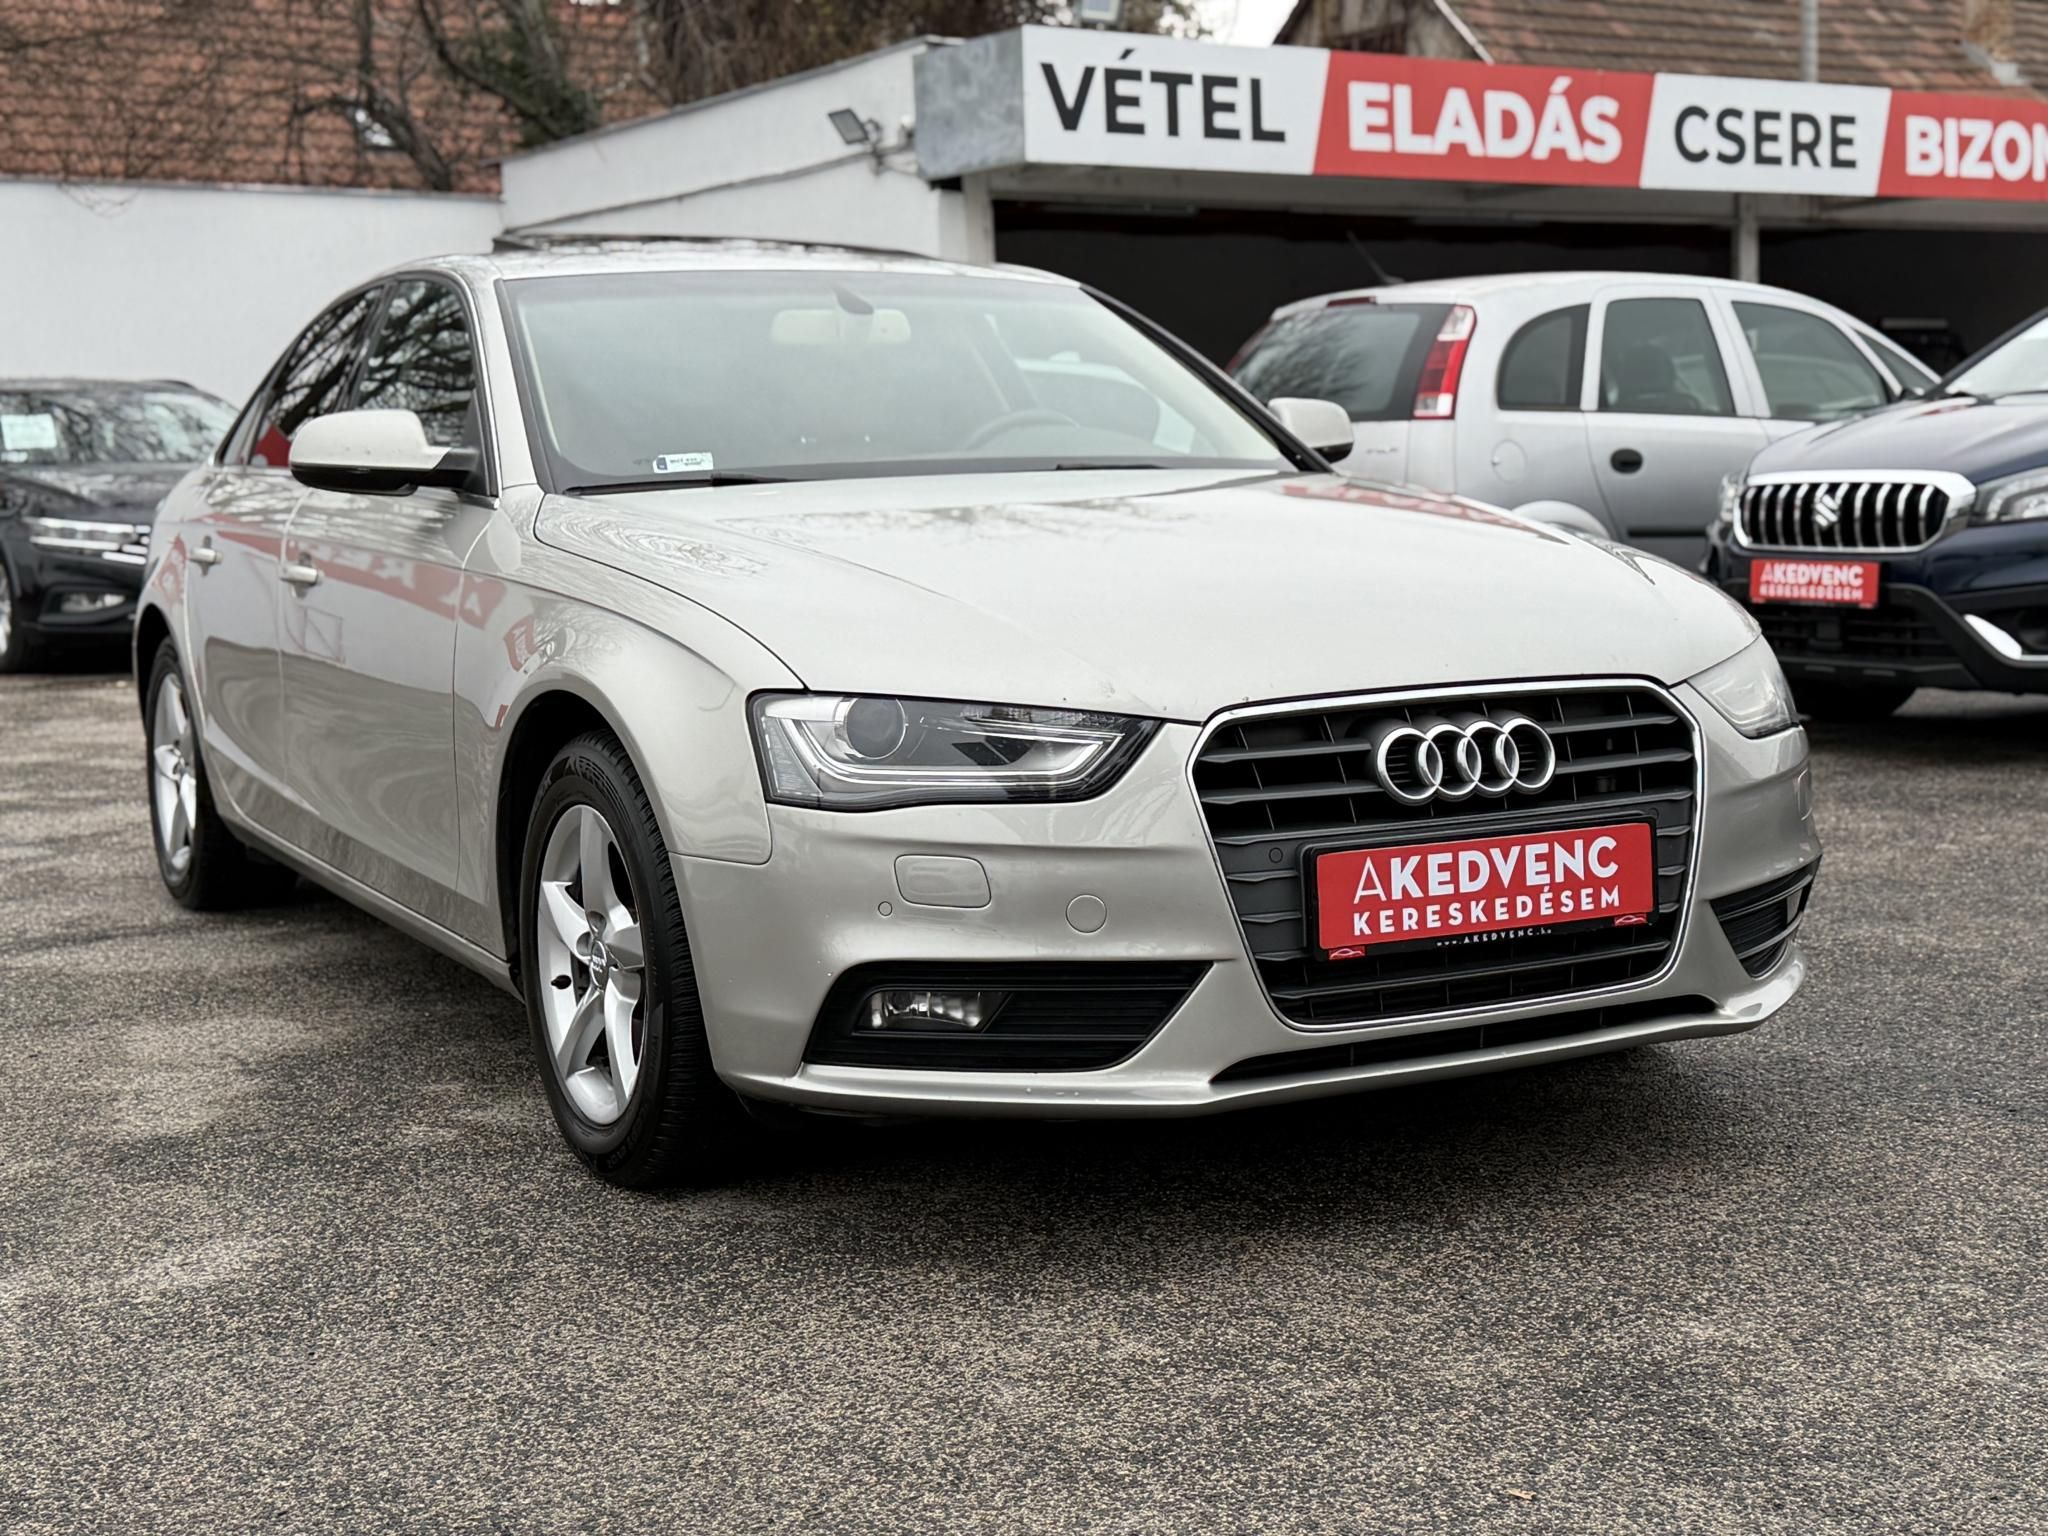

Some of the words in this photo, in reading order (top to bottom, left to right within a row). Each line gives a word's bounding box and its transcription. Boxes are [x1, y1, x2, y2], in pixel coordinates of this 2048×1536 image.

[1041, 48, 1286, 142] VÉTEL
[1347, 76, 1623, 164] ELADÁS
[1674, 105, 1858, 169] CSERE
[1353, 836, 1619, 905] AKEDVENC
[1353, 885, 1621, 936] KERESKEDÉSEM
